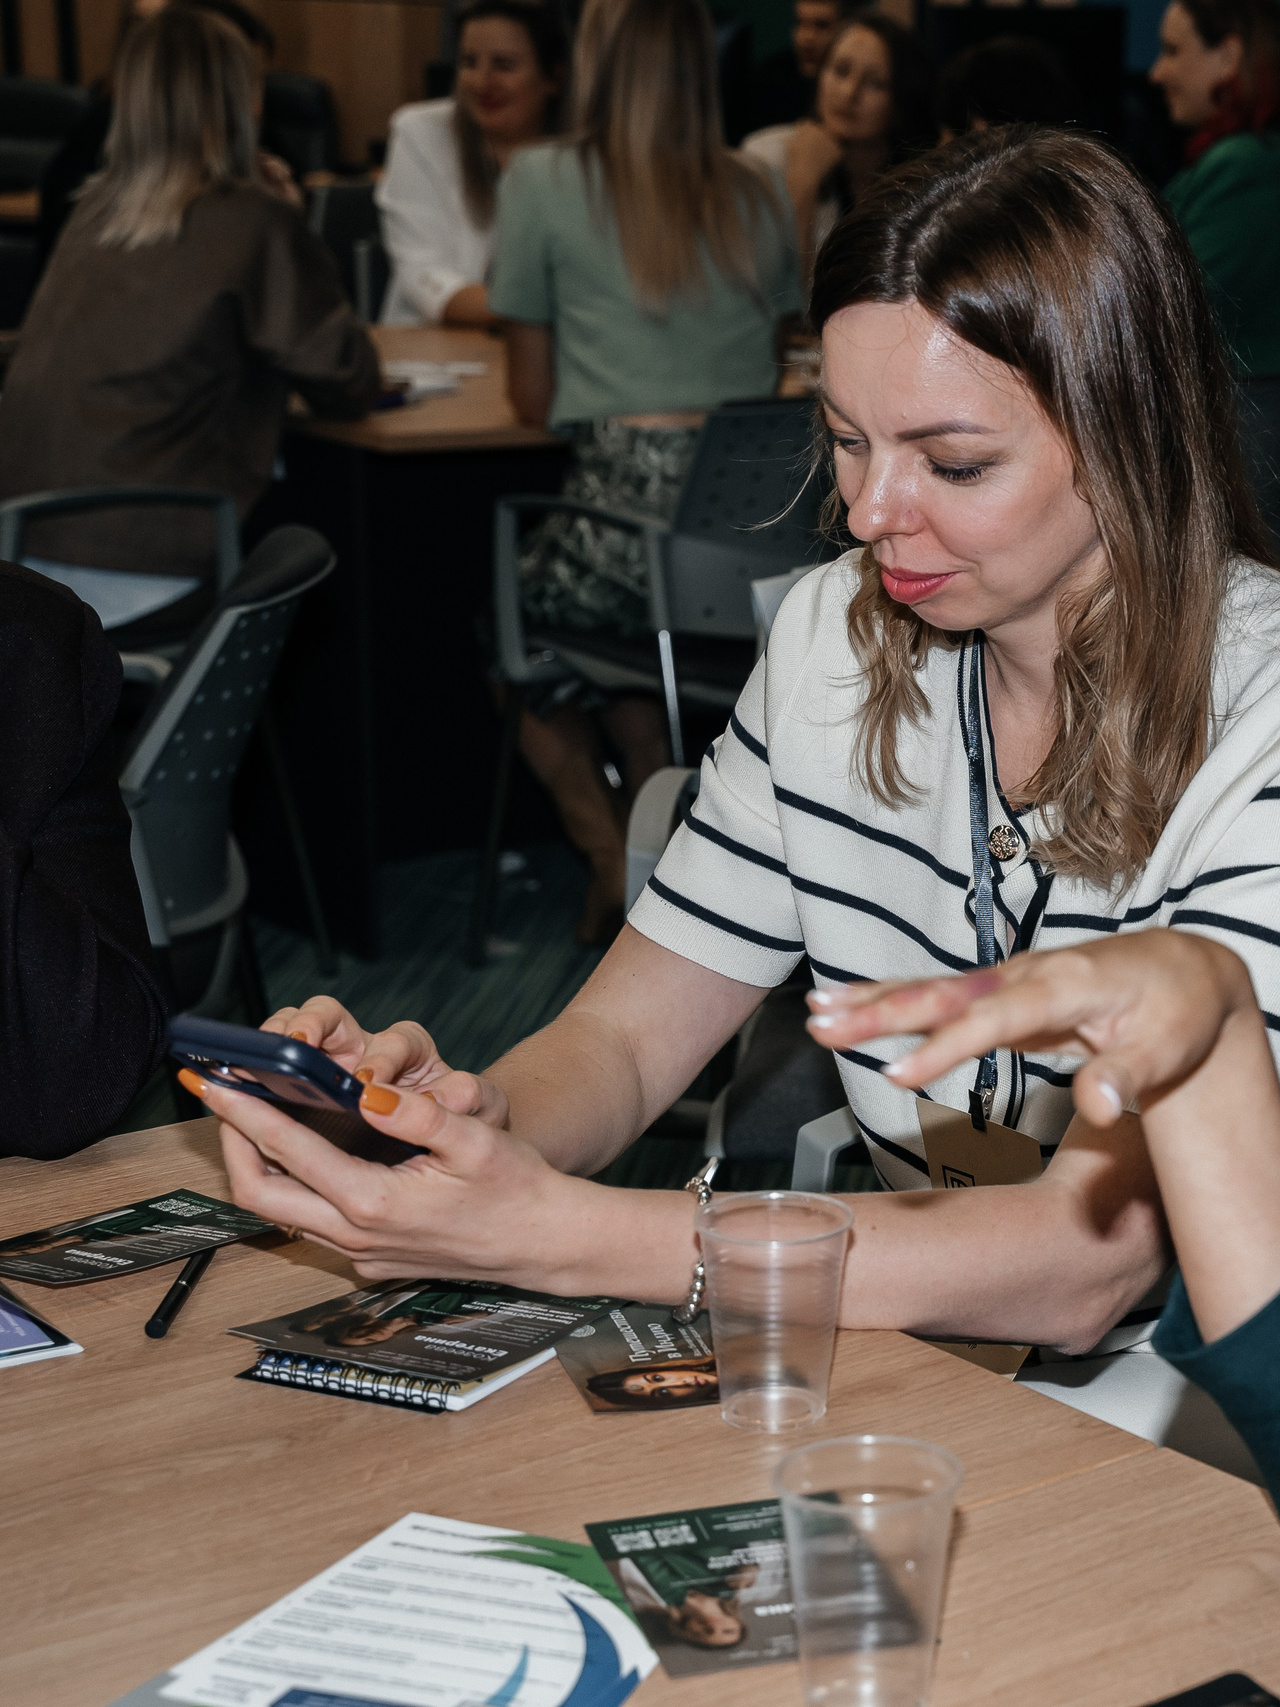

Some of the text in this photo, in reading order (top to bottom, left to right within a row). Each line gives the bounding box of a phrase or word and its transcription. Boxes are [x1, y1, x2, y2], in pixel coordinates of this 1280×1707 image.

[414, 1335, 509, 1357] Екатерина
[609, 1309, 656, 1362] Путешестви
[647, 1323, 678, 1353] Индию
[424, 1344, 498, 1362] Козеева
